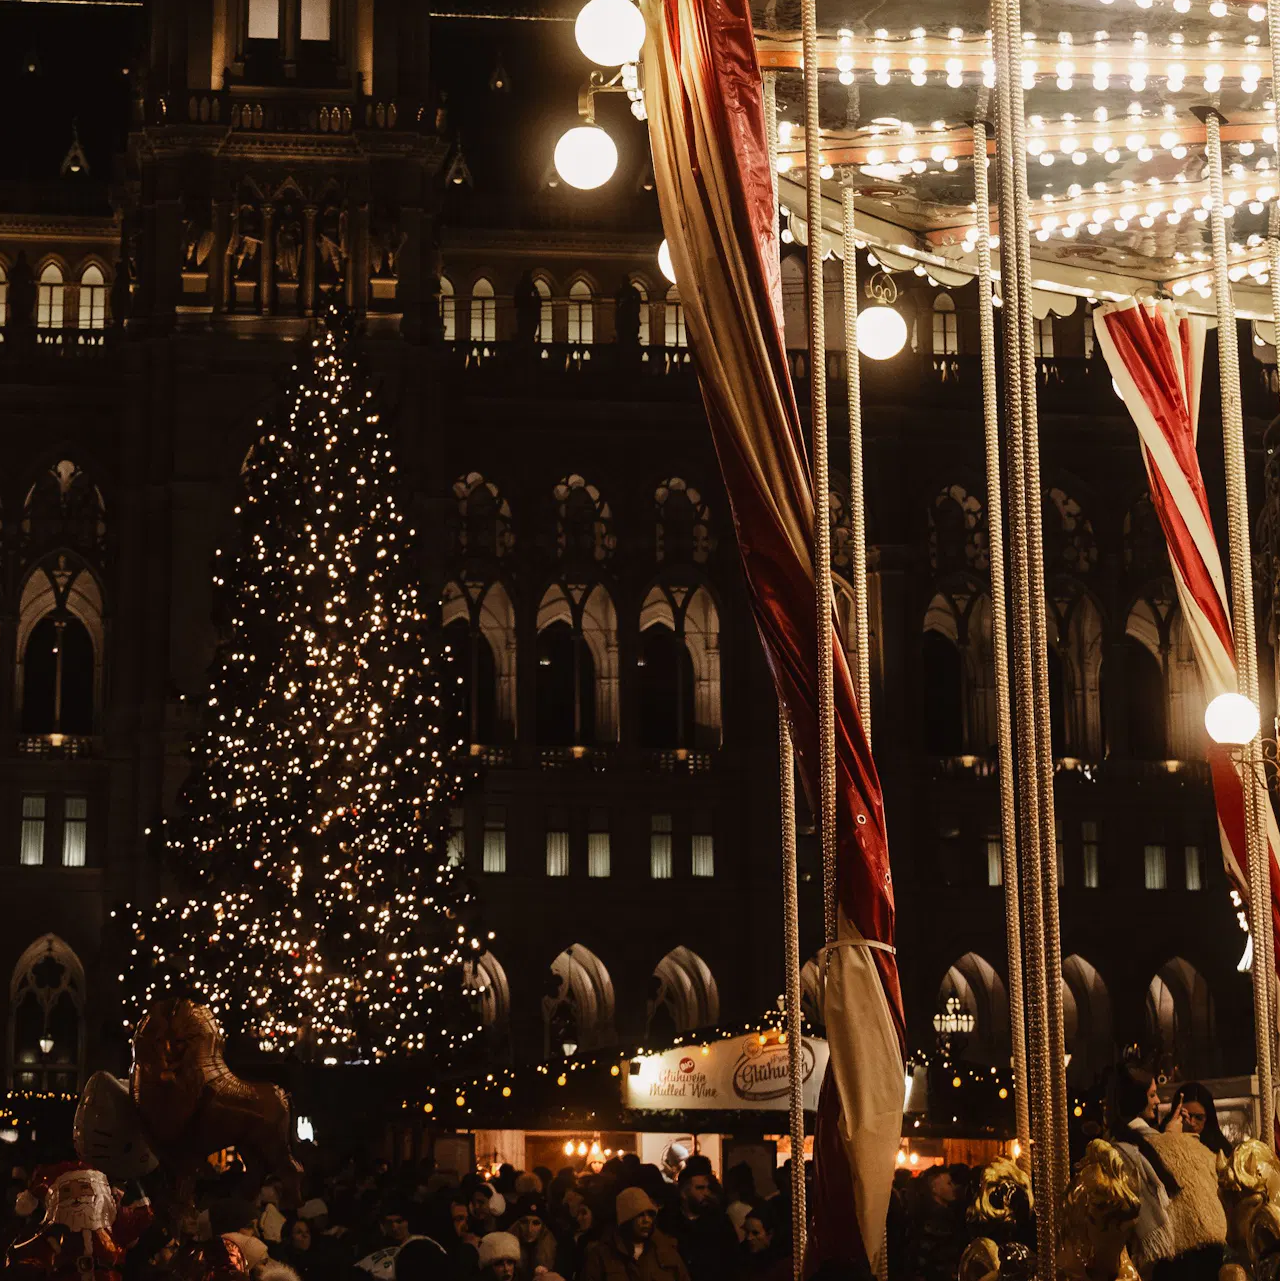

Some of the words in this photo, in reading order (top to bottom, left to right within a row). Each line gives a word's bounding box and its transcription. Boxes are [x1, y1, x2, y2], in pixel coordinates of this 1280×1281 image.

[741, 1061, 809, 1091] Glühwn
[649, 1082, 686, 1097] Mulled
[689, 1082, 718, 1098] Wine
